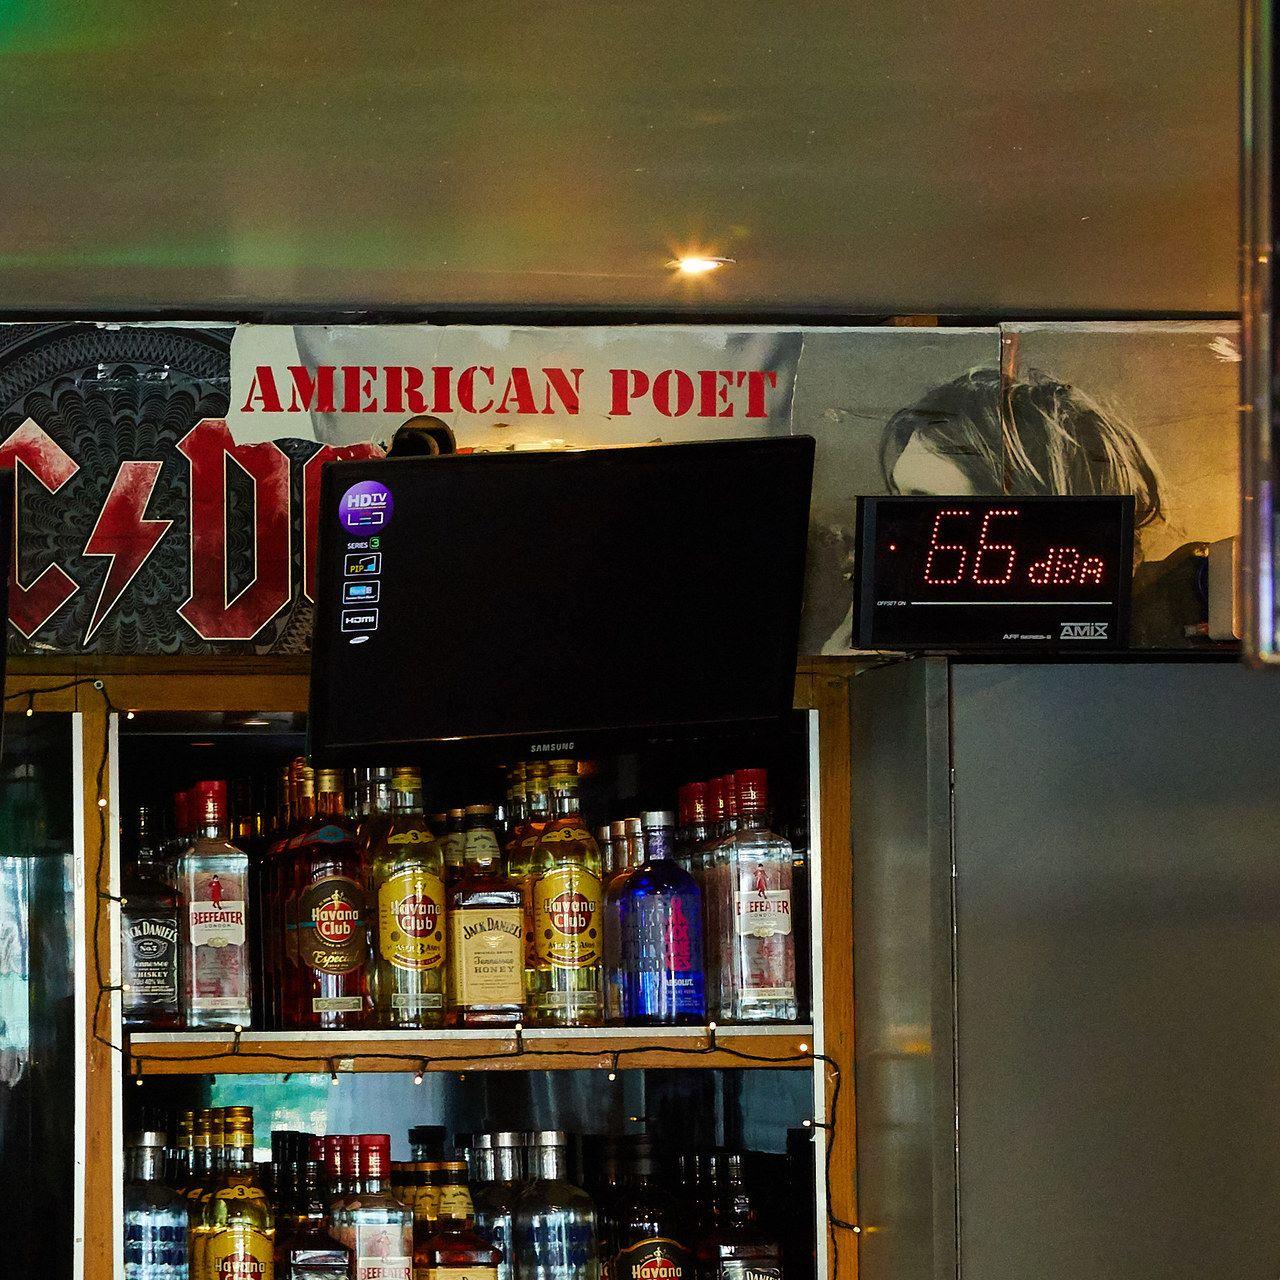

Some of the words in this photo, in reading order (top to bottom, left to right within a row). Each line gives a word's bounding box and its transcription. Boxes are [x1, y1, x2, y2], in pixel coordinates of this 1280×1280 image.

[240, 364, 585, 417] AMERICAN
[608, 368, 779, 420] POET
[923, 509, 1020, 585] 66
[530, 741, 575, 753] SAMSUNG
[390, 900, 442, 917] Havana
[543, 897, 595, 913] Havana
[191, 909, 244, 926] BEEFEATER
[311, 907, 359, 922] Havana
[553, 913, 587, 928] Club
[320, 919, 351, 935] Club
[400, 915, 433, 931] Club
[462, 921, 487, 940] JACK
[142, 921, 179, 943] DANIEL'S
[474, 966, 515, 974] HONEY
[214, 1258, 266, 1275] Havana
[631, 1264, 682, 1280] Havana
